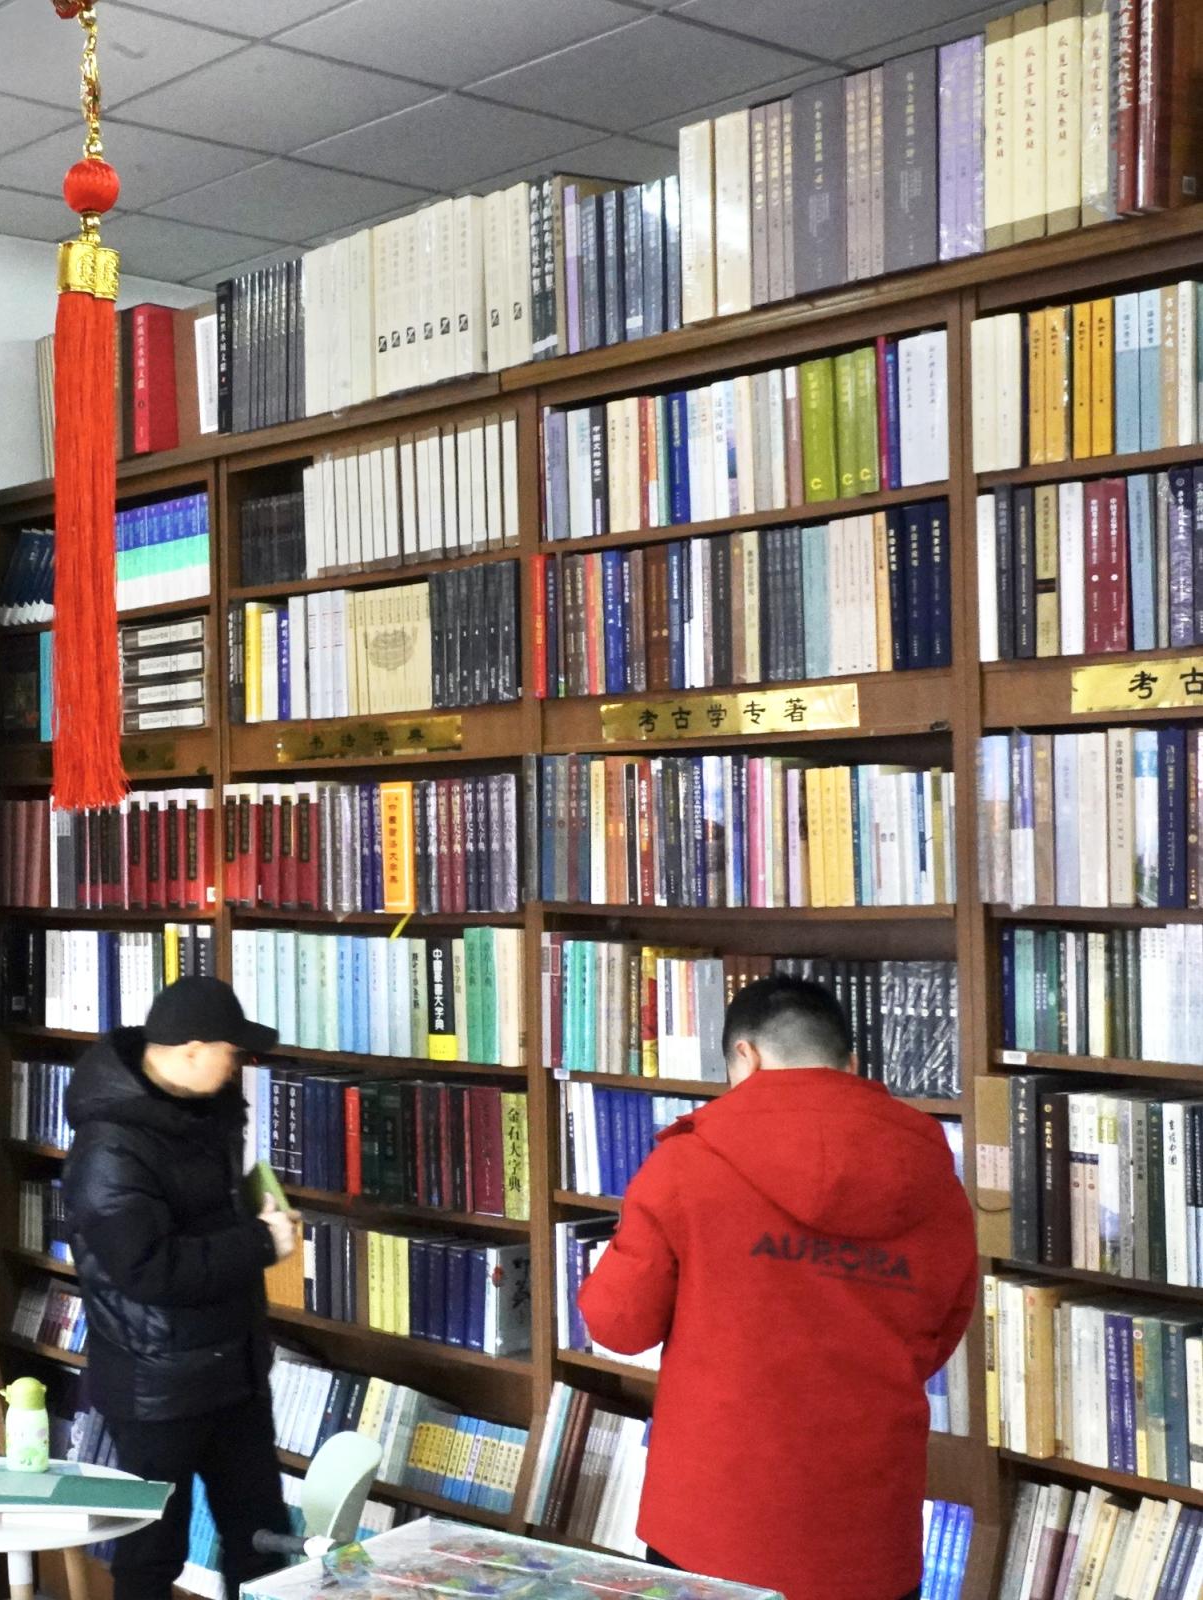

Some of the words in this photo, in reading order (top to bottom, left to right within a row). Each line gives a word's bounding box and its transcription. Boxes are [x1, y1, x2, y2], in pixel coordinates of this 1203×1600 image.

[1128, 667, 1203, 700] 考古
[638, 698, 807, 733] 考古学专著
[505, 1107, 524, 1194] 金石大字典
[751, 1231, 912, 1280] AURORA
